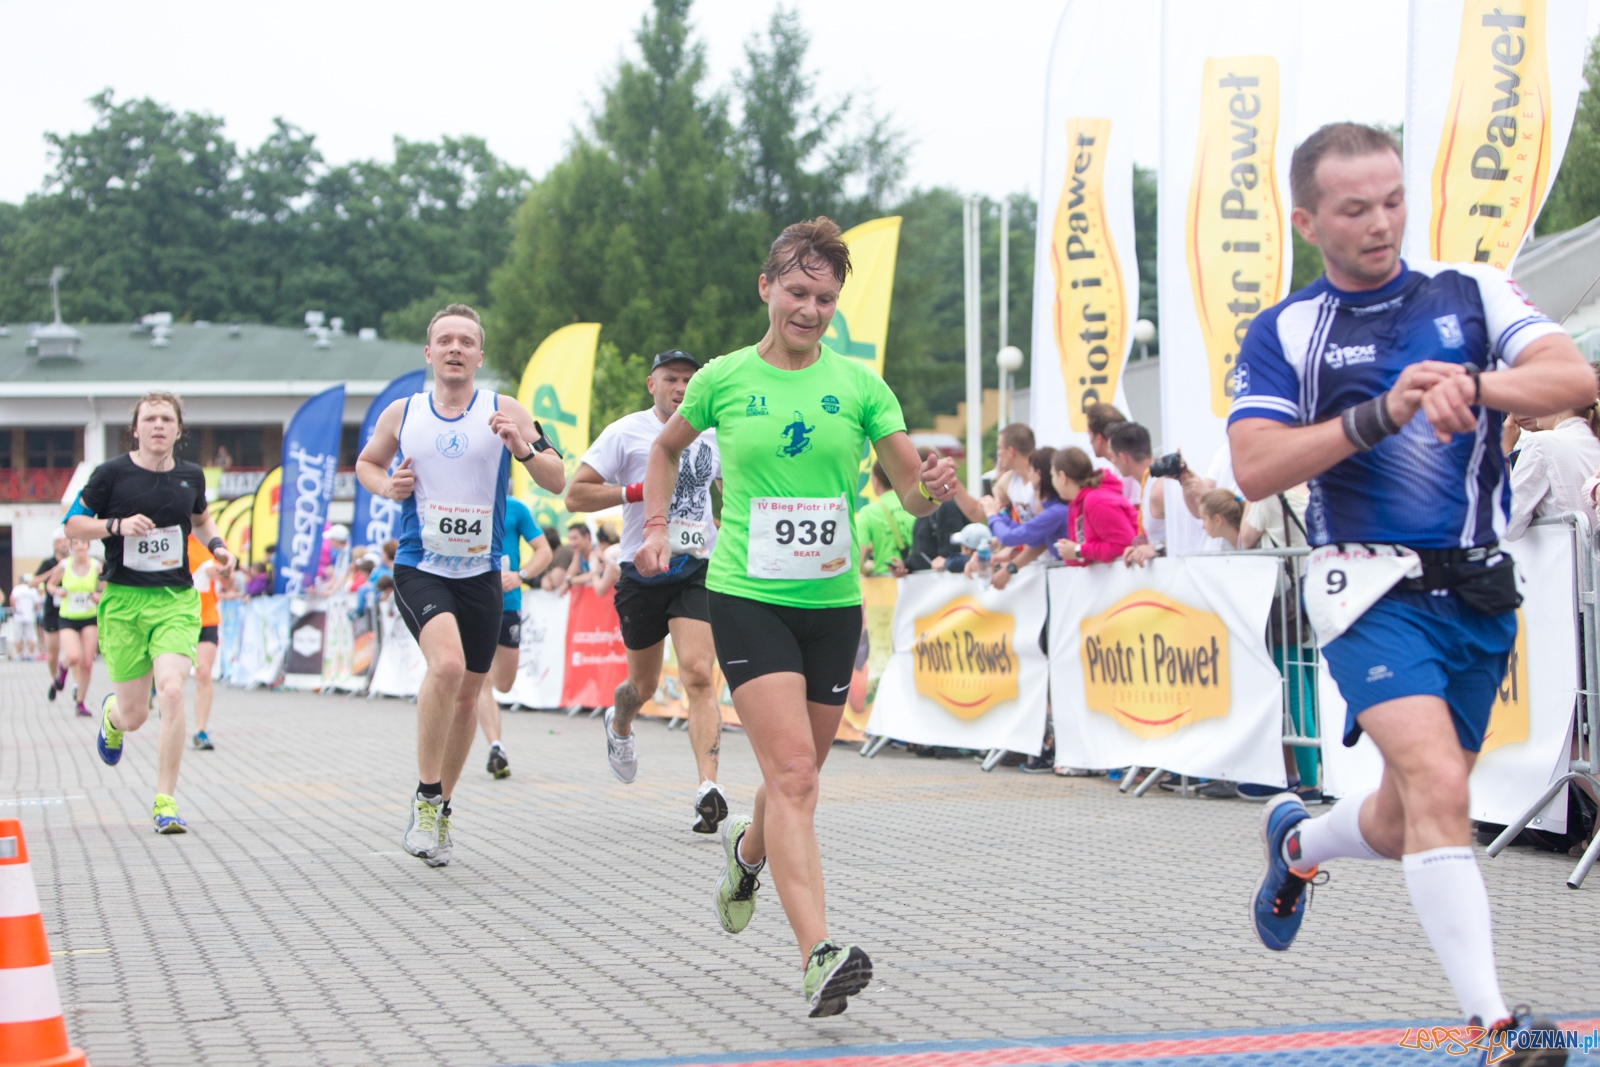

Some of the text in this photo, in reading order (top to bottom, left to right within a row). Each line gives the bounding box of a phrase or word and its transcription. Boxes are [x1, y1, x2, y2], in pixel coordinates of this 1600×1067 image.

[1469, 7, 1527, 219] i Paweł
[1493, 89, 1536, 271] PERMARKET
[1219, 72, 1261, 398] otr i Paweł
[1071, 277, 1102, 289] i
[1079, 303, 1110, 414] Piotr
[746, 395, 768, 408] 21
[281, 447, 325, 596] ehasport
[438, 504, 453, 513] Bieg
[454, 506, 470, 514] Piotr
[758, 502, 768, 510] IV
[771, 502, 793, 512] Bieg
[797, 503, 820, 511] Piotr
[439, 517, 482, 536] 684
[775, 519, 837, 546] 938
[138, 538, 170, 554] 836
[916, 631, 1012, 675] Piotr i Paweł
[1086, 633, 1220, 686] Piotr i Paweł
